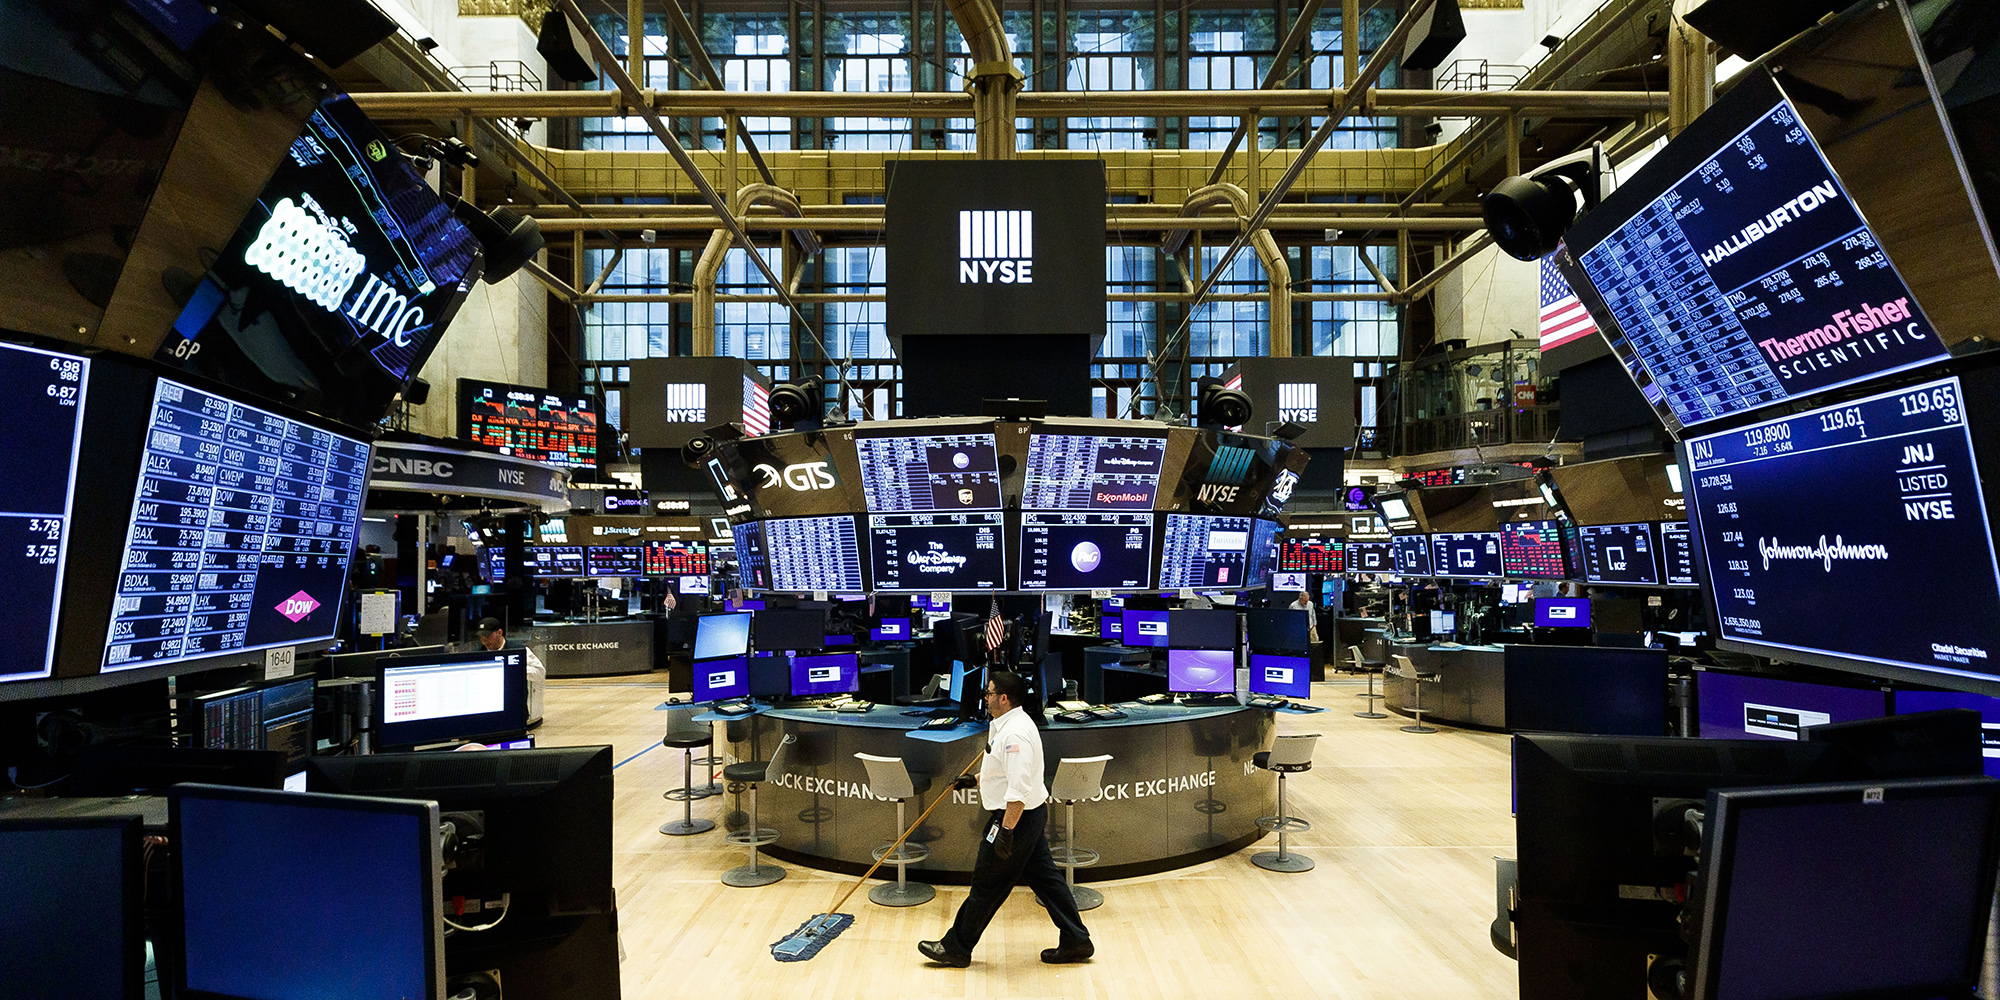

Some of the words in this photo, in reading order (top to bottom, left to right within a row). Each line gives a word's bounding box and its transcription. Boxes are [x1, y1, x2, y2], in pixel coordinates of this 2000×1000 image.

[1666, 190, 1682, 204] HAL
[1699, 159, 1720, 179] 5.0500
[1736, 134, 1753, 151] 5.05
[1771, 107, 1791, 125] 5.07
[1715, 177, 1731, 192] 5.10
[1747, 153, 1765, 170] 5.36
[1784, 126, 1803, 144] 4.56
[1701, 179, 1838, 267] HALLIBURTON
[959, 261, 1033, 284] NYSE
[1728, 291, 1747, 306] TMO
[1760, 270, 1790, 289] 278.3700
[1802, 252, 1828, 269] 278.19
[1842, 231, 1871, 250] 278.39
[1739, 302, 1768, 321] 3,702,163
[1778, 288, 1801, 304] 278.03
[1814, 270, 1840, 288] 285.45
[1855, 251, 1885, 270] 268.15
[1759, 296, 1912, 363] ThermoFisher
[174, 338, 201, 360] 6P
[1779, 322, 1926, 379] SCIENTIFIC
[50, 358, 81, 374] 6.98
[60, 371, 79, 382] 986
[47, 384, 77, 399] 6.87
[1517, 391, 1535, 400] CNN
[59, 398, 76, 407] LOW
[204, 398, 227, 412] 62.9300
[157, 409, 174, 422] AIG
[232, 406, 244, 419] CCI
[667, 409, 706, 423] NYSE
[1279, 409, 1317, 422] NYSE
[200, 419, 223, 433] 19.2300
[505, 417, 519, 425] NYA
[537, 420, 550, 428] RUT
[568, 423, 580, 431] SPX
[1694, 440, 1713, 460] JNJ
[1744, 422, 1791, 447] 119.8900
[1819, 406, 1865, 433] 119.61
[1899, 386, 1956, 417] 119.65
[1753, 446, 1768, 457] -7.16
[1773, 441, 1794, 453] -5.64%
[1860, 426, 1867, 438] 1
[1942, 407, 1959, 424] 58
[199, 442, 219, 455] 0.5100
[223, 448, 245, 462] CWEN
[1901, 443, 1935, 465] JNJ
[549, 451, 568, 461] IBM
[148, 456, 171, 470] ALEX
[195, 464, 215, 475] 8.8400
[372, 456, 453, 478] CNBC
[498, 468, 525, 486] NYSE
[783, 461, 836, 492] GTS
[143, 479, 159, 493] ALL
[1700, 474, 1732, 488] 19,728,534
[1899, 473, 1948, 492] LISTED
[188, 485, 211, 497] 73.8700
[216, 490, 234, 502] DOW
[1197, 484, 1240, 503] NYSE
[1096, 492, 1148, 504] ExxonMobil
[138, 503, 159, 516] AMT
[180, 507, 207, 519] 195.3900
[1717, 502, 1738, 514] 126.83
[1904, 500, 1955, 521] NYSE
[29, 519, 60, 532] 3.79
[604, 526, 640, 536] J.Streicher
[47, 530, 59, 539] 12
[134, 527, 154, 540] BAX
[179, 530, 203, 541] 75.7500
[1722, 531, 1743, 542] 127.44
[26, 545, 57, 557] 3.75
[928, 541, 943, 550] The
[129, 551, 148, 563] BDX
[171, 552, 199, 562] 220.1200
[203, 554, 217, 565] EW
[919, 565, 955, 574] Company
[1728, 560, 1749, 570] 118.13
[124, 575, 149, 587] BDXA
[195, 595, 211, 606] LHX
[1733, 588, 1755, 600] 123.02
[115, 621, 134, 635] BSX
[1723, 616, 1761, 629] 2,636,350,000
[187, 637, 202, 648] NEE
[549, 643, 575, 651] STOCK
[576, 641, 619, 650] EXCHANGE
[1931, 643, 1953, 655] Citadel
[1954, 645, 1988, 659] Securities
[270, 650, 292, 667] 1640
[1243, 759, 1260, 776] NE
[805, 776, 898, 803] EXCHAN
[952, 788, 983, 804] NE
[1135, 770, 1216, 798] EXCHANGE
